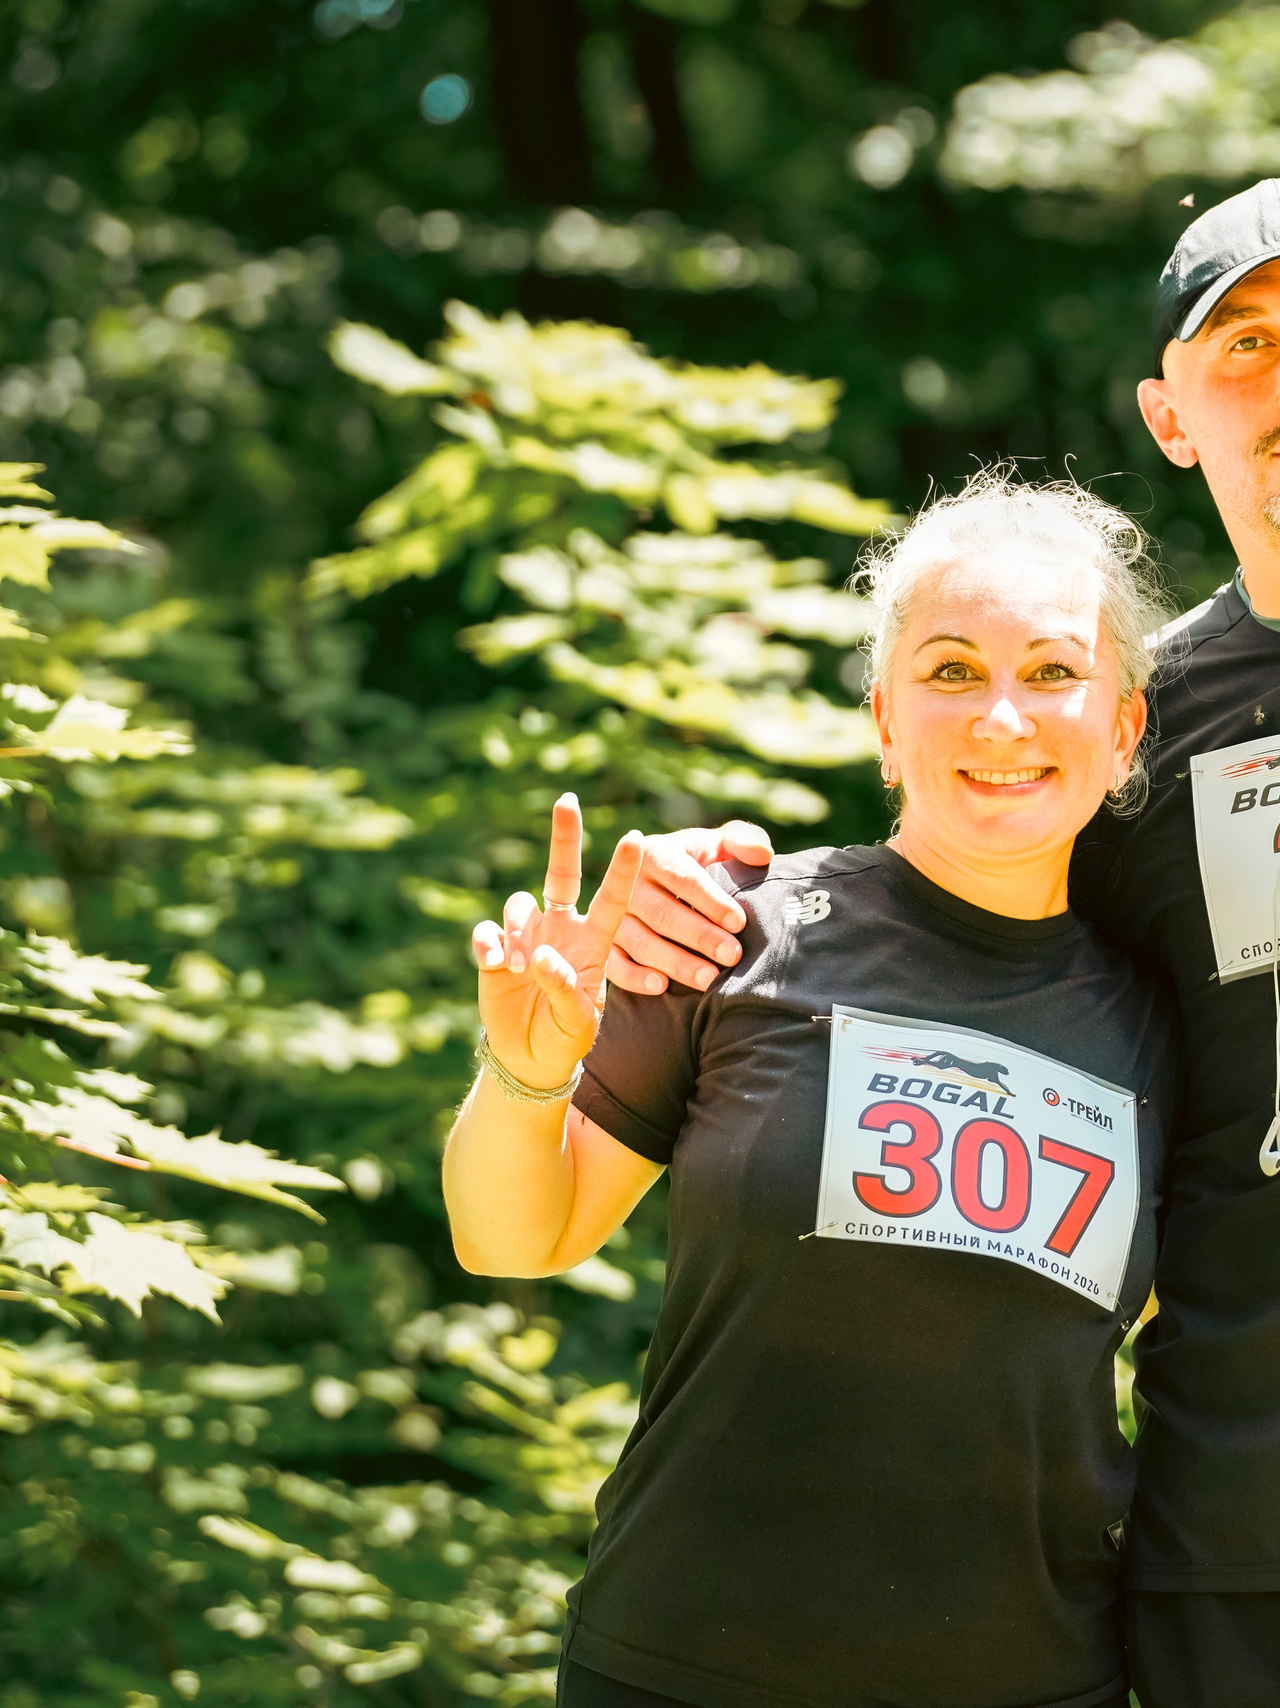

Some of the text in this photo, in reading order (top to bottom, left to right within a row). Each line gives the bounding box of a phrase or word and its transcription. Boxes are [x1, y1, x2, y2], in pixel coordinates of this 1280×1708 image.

[866, 1073, 1015, 1120] BOGAL
[852, 1100, 1116, 1258] 307
[845, 1222, 1100, 1295] СПОРТИВНЫЙ МАРАФОН 2026
